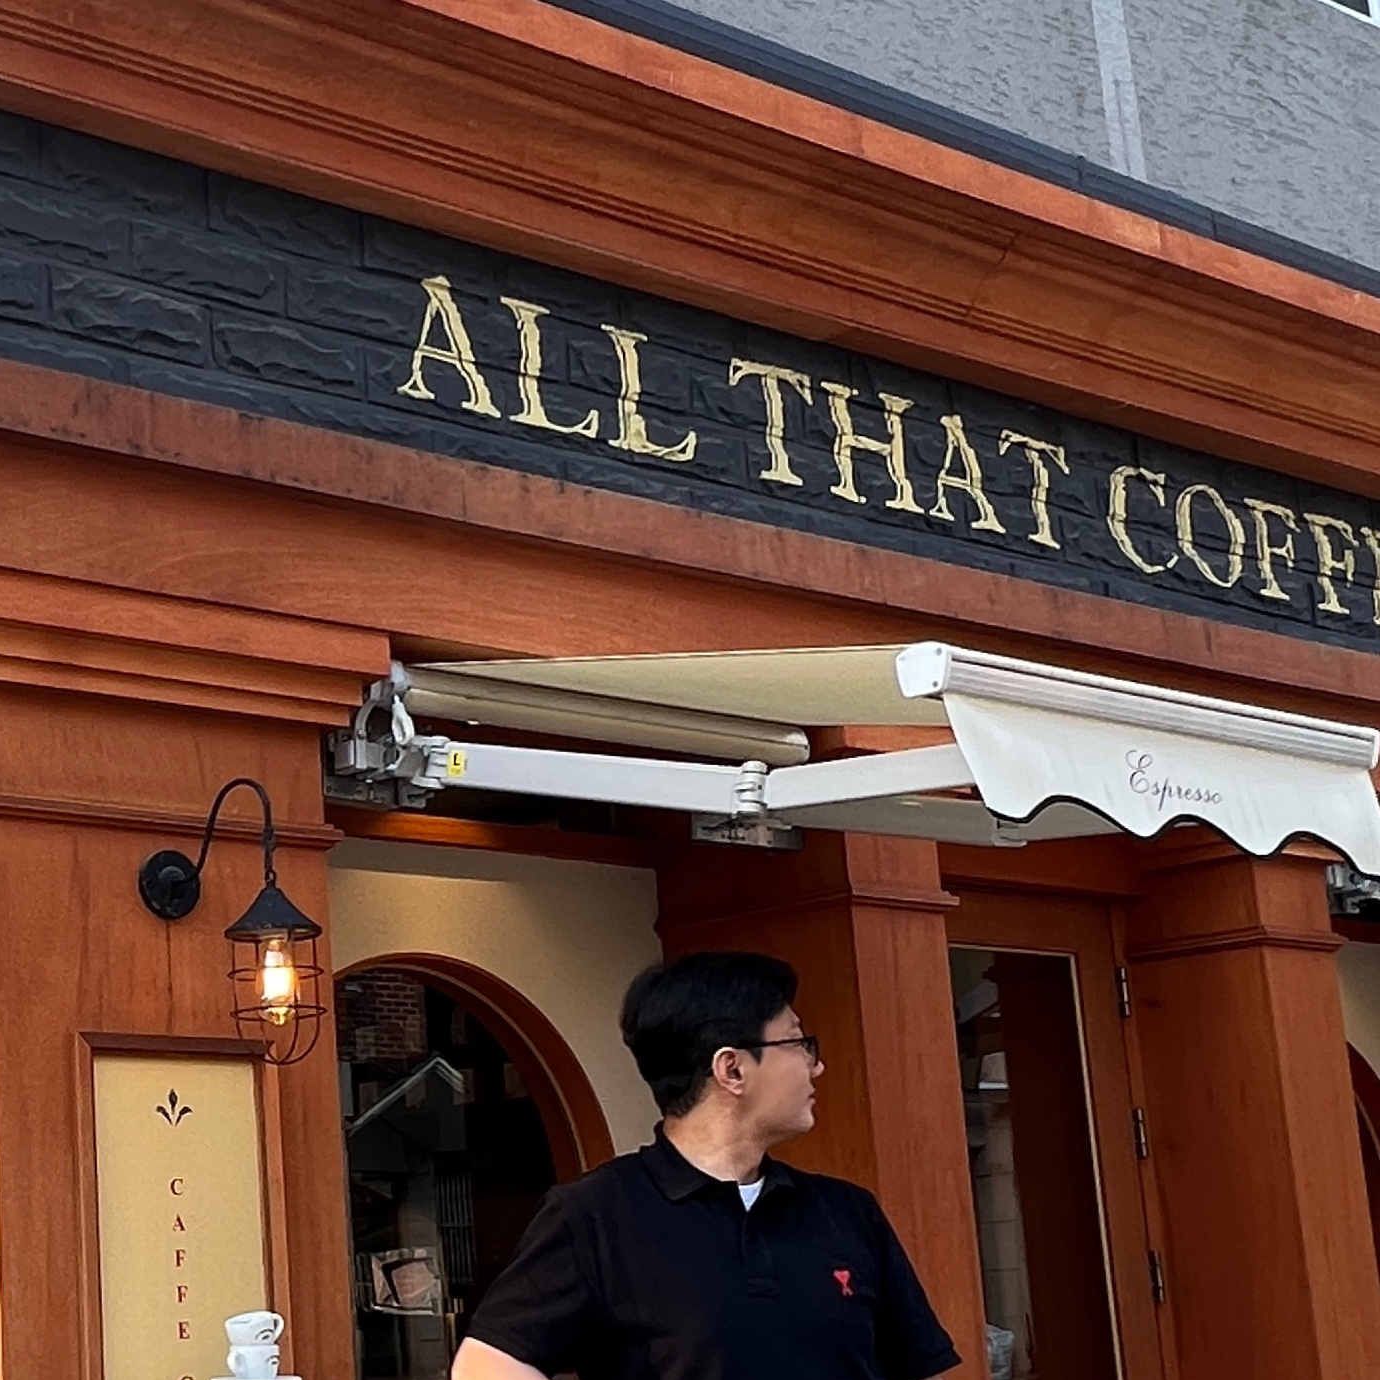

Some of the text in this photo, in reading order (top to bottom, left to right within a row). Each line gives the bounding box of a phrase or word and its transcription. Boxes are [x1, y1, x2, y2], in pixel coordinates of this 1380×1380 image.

[396, 274, 698, 462] ALL
[728, 356, 1070, 550] THAT
[1124, 749, 1222, 811] Espresso
[170, 1178, 191, 1340] CAFFE
